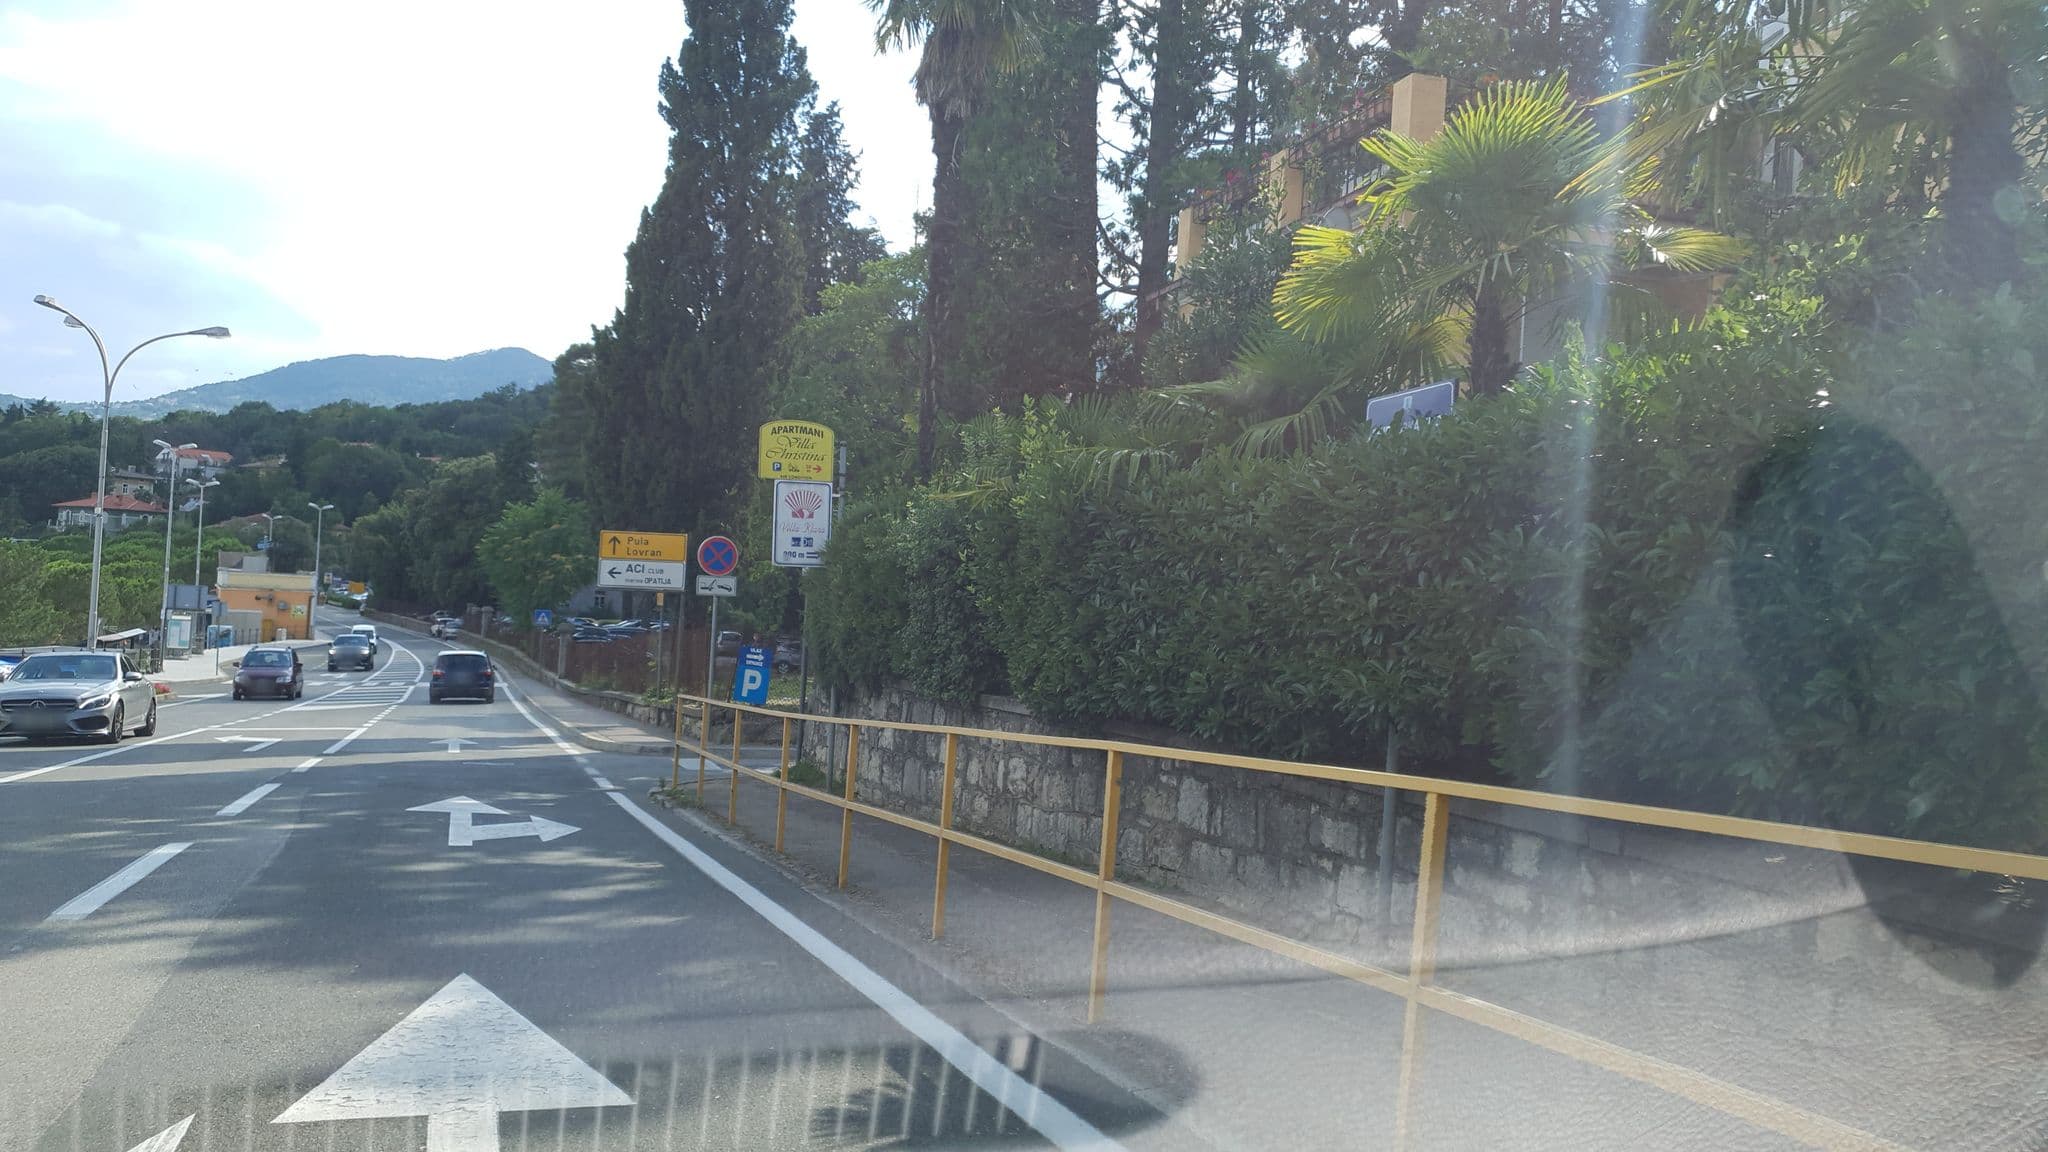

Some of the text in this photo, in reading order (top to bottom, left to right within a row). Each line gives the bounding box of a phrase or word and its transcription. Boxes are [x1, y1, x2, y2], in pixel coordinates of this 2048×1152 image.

[771, 425, 824, 439] APARTMANI
[777, 435, 816, 449] Villa
[766, 447, 826, 461] Christina
[627, 548, 662, 557] Lovran
[626, 564, 645, 574] ACI
[741, 668, 762, 697] P
